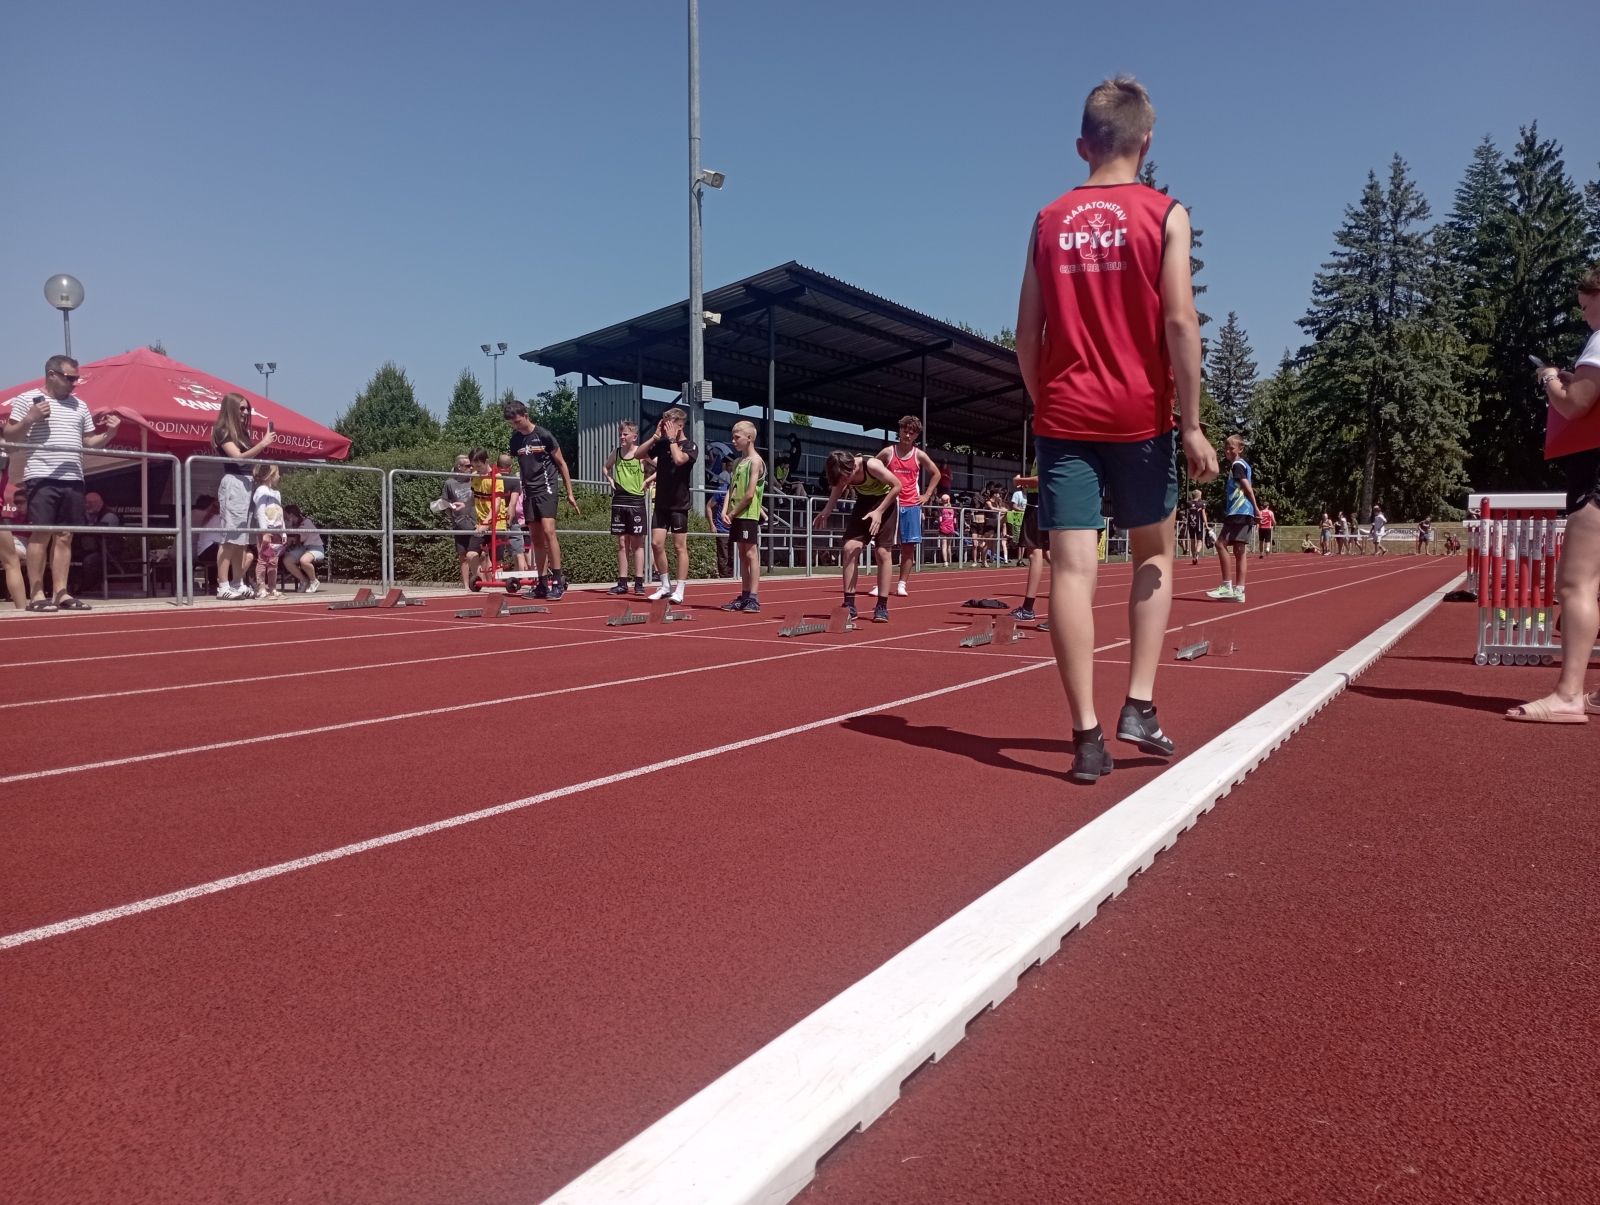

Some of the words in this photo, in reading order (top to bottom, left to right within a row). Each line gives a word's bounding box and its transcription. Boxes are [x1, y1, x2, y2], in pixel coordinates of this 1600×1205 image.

[1063, 201, 1127, 225] MARATONSTAV
[1060, 264, 1086, 274] CZECH
[1087, 261, 1127, 272] REPUBLIC
[633, 525, 643, 534] 27
